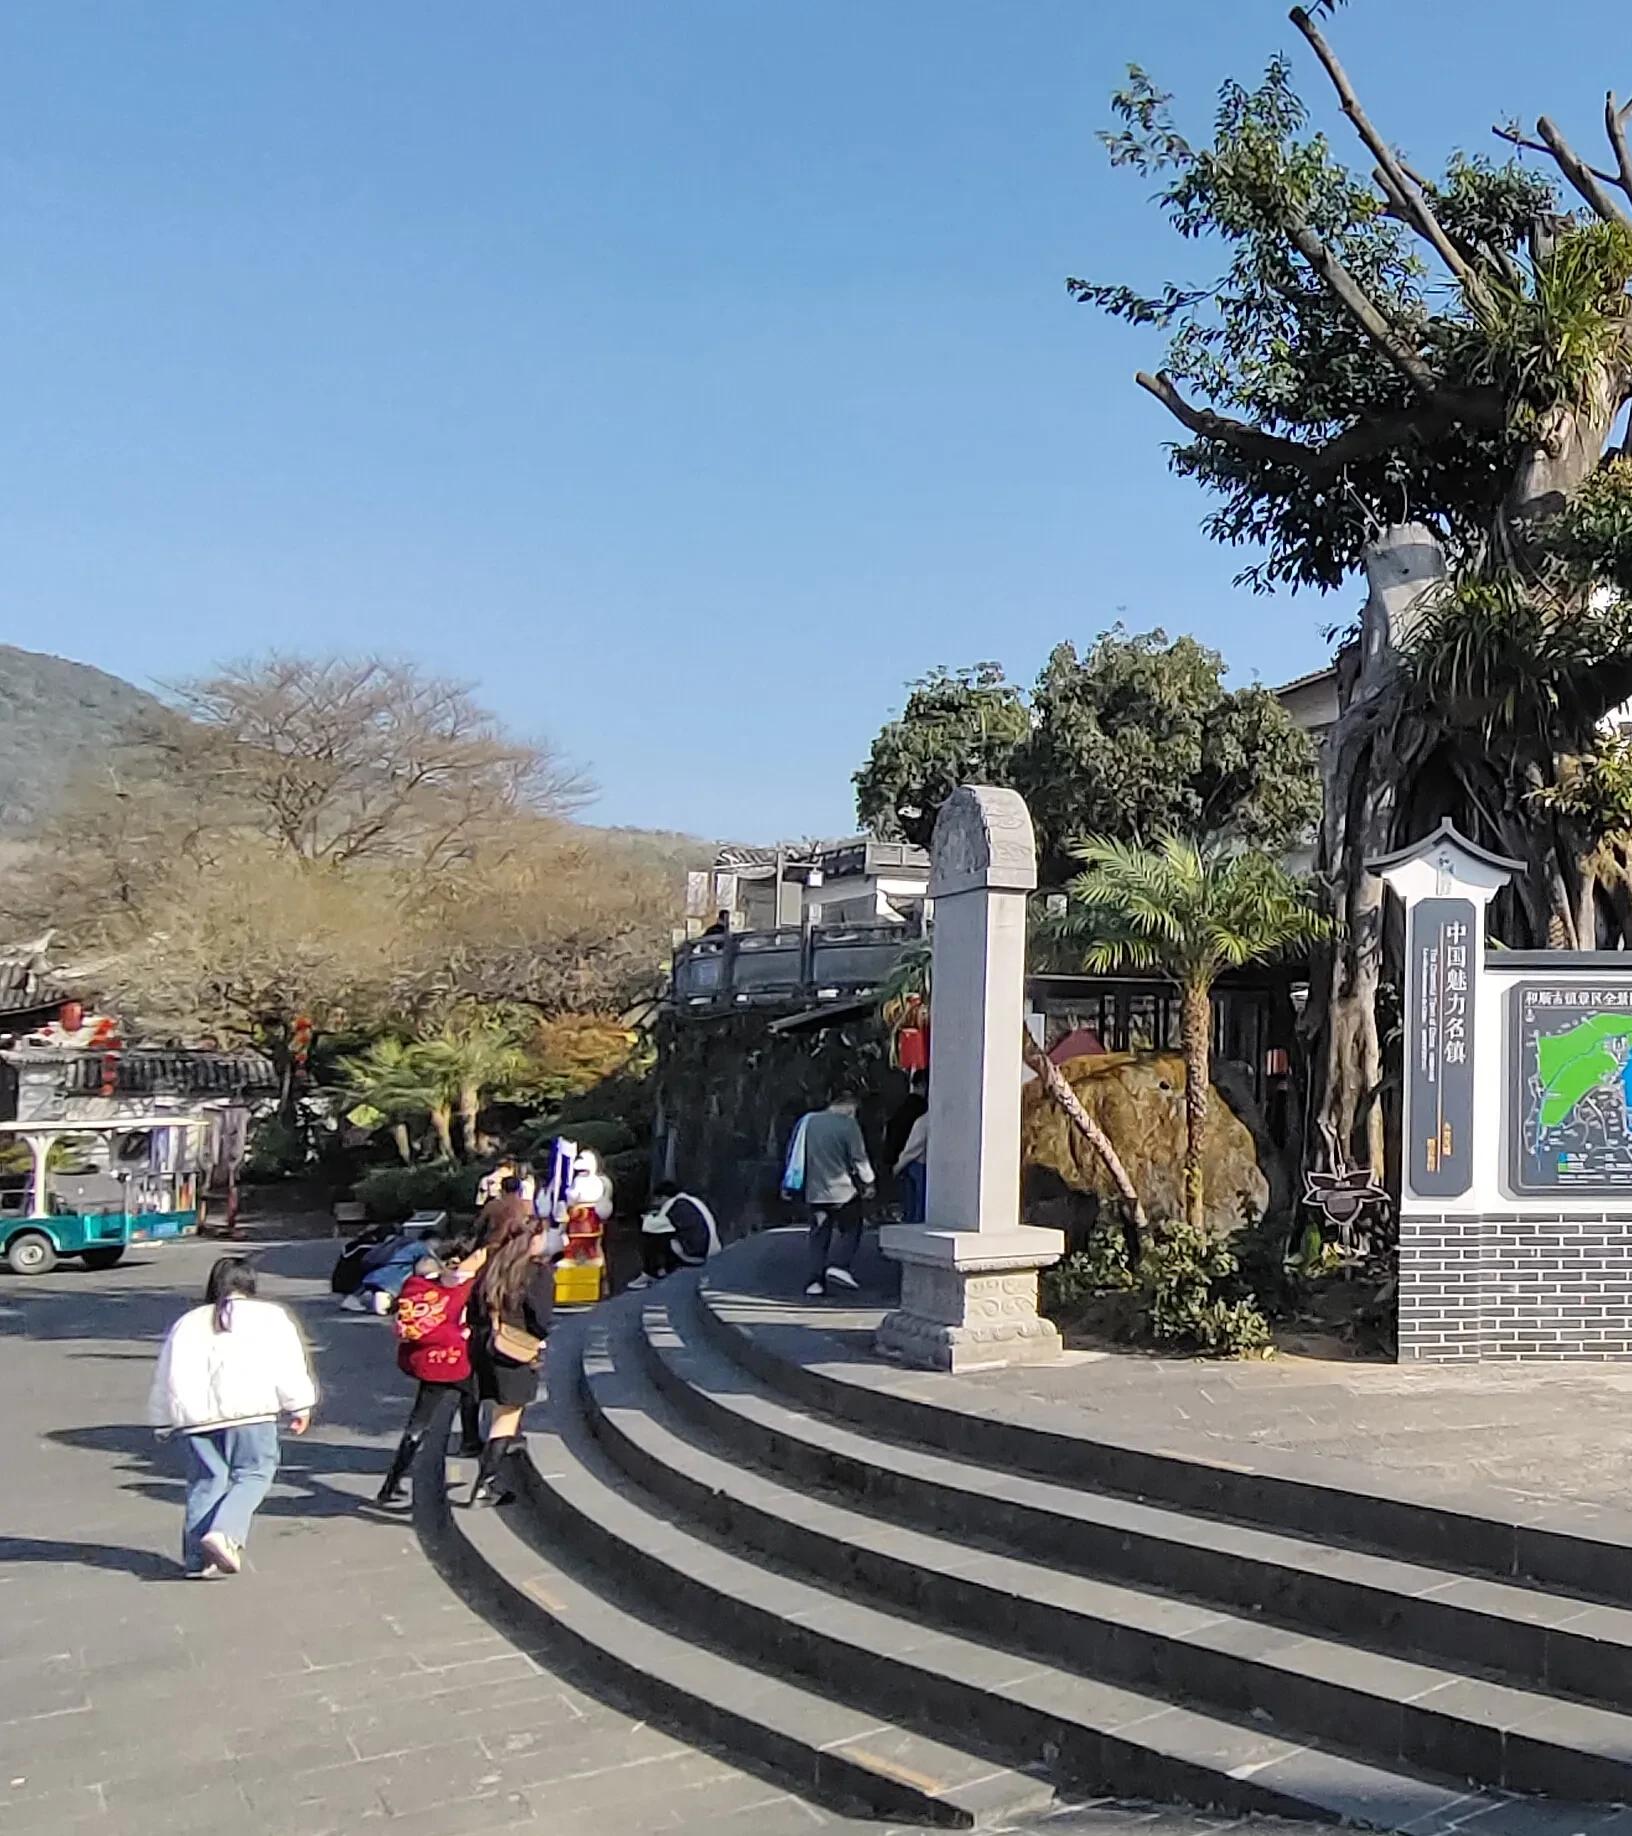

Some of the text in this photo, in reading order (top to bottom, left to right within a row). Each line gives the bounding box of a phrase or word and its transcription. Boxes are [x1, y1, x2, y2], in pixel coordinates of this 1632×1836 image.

[1444, 919, 1468, 1064] 中国魅力名镇
